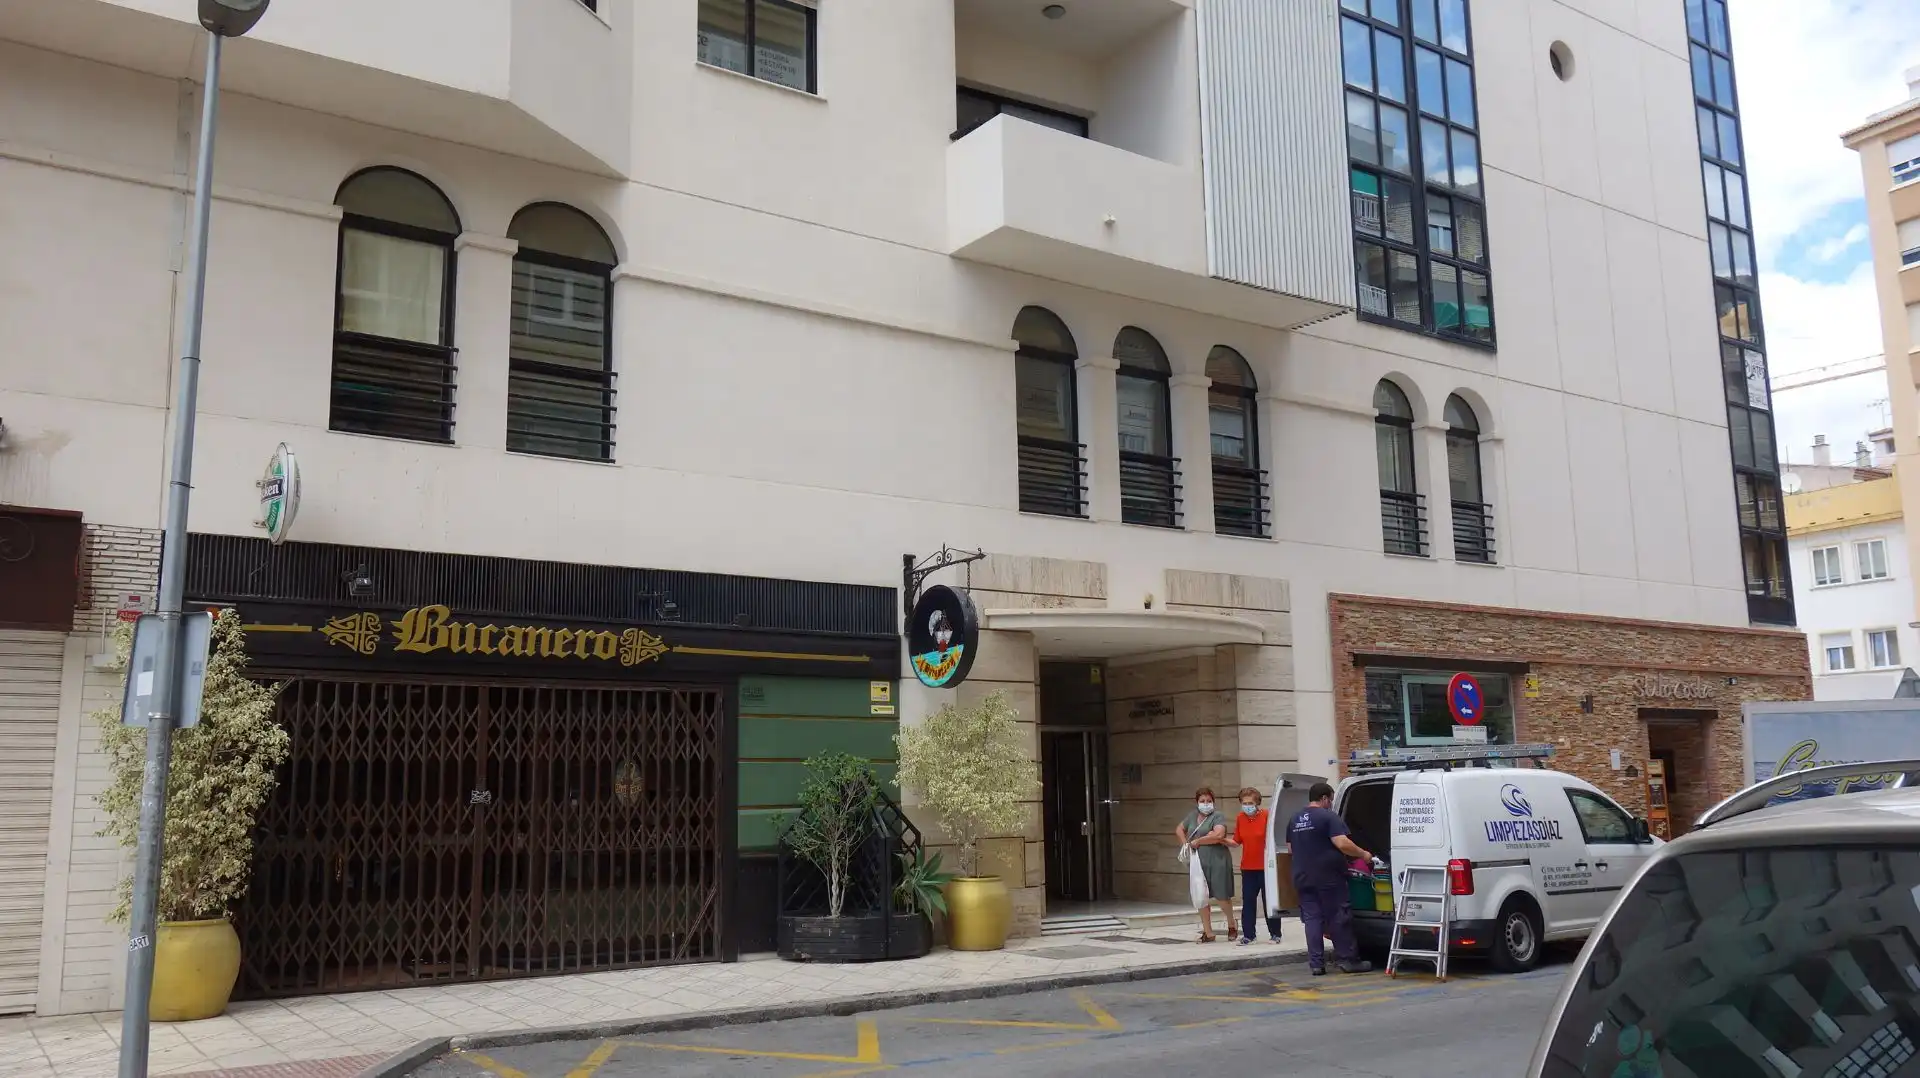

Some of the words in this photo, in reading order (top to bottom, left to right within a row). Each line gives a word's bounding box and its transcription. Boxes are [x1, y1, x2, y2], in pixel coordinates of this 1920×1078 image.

[390, 604, 619, 661] Bucanero
[1398, 816, 1435, 824] PARTICULARES
[1398, 825, 1425, 834] EMPRESAS
